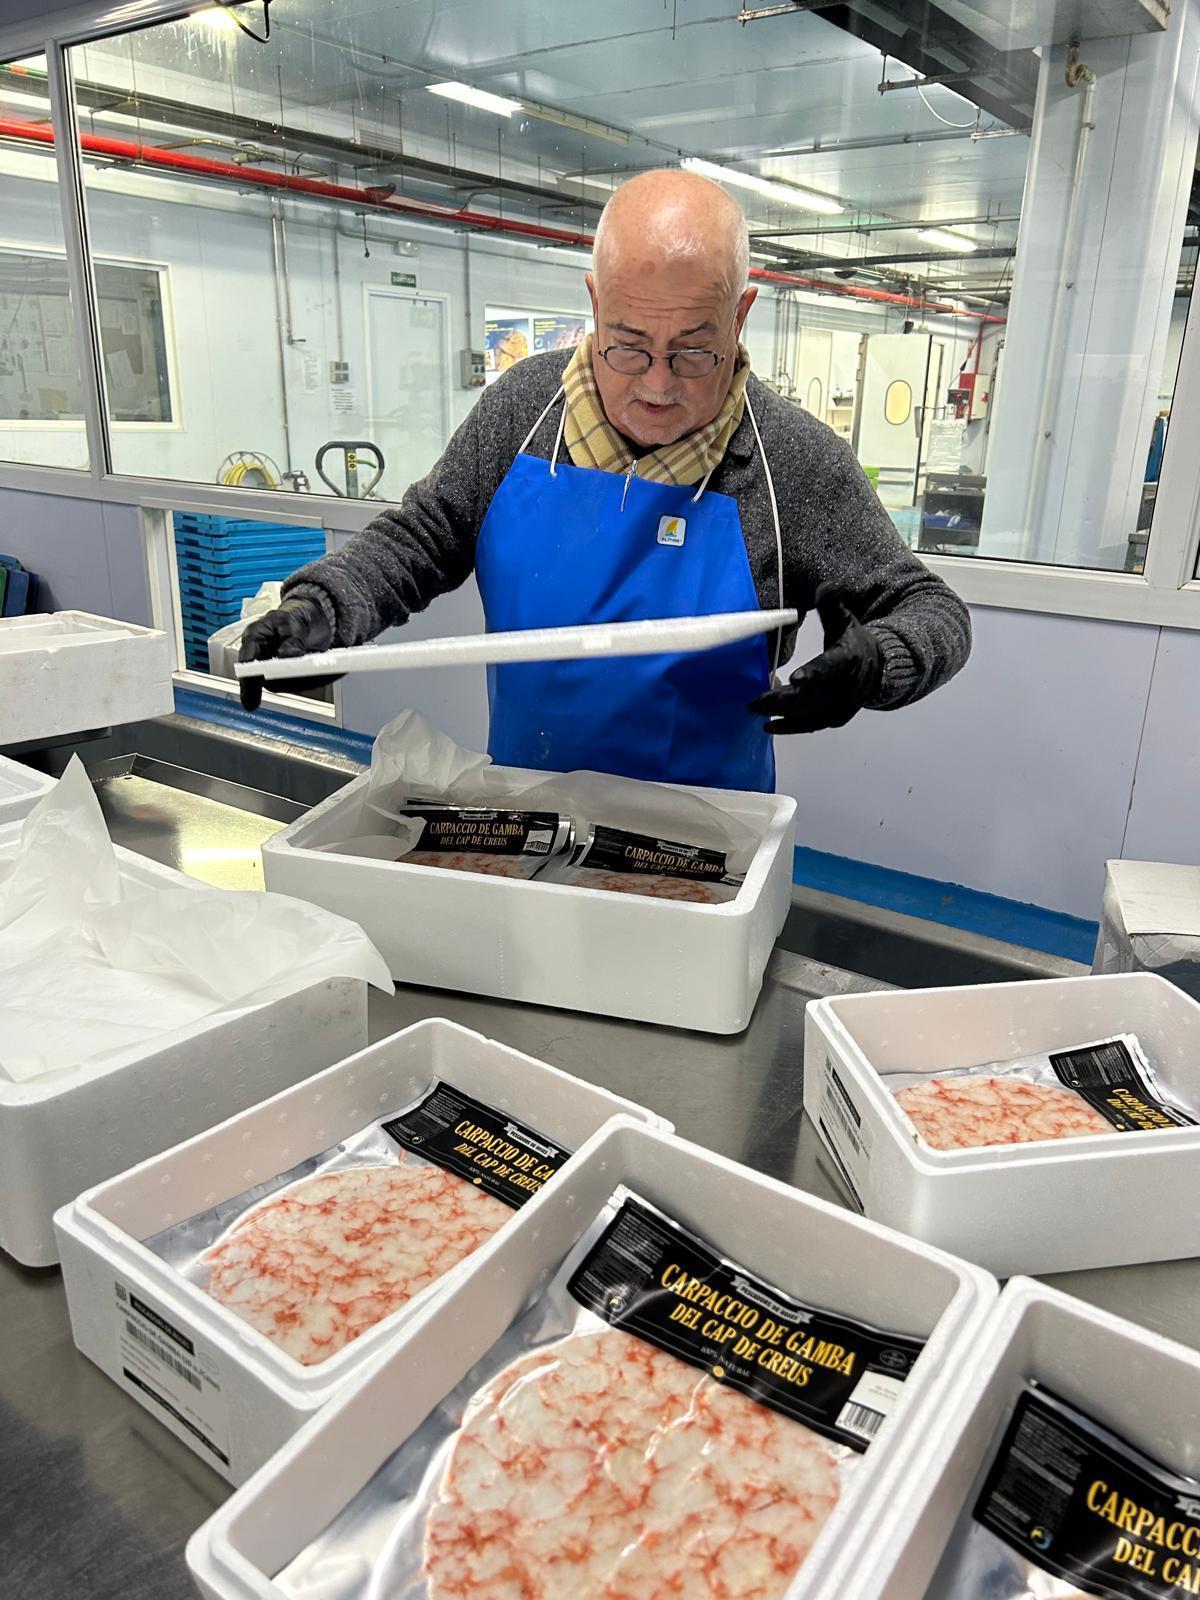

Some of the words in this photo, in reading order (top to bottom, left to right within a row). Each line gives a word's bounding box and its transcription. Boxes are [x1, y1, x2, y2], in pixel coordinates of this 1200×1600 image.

[429, 822, 476, 834] CARPACCIO
[478, 823, 491, 835] DE
[492, 823, 524, 836] GAMBA
[440, 836, 454, 845] DEL
[456, 836, 470, 845] CAP
[471, 836, 482, 845] DE
[483, 837, 508, 846] CREUS
[624, 845, 674, 865] CARPACCIO
[676, 856, 691, 868] DE
[453, 1143, 478, 1158] DEL
[473, 1153, 499, 1169] CAP
[493, 1163, 514, 1178] DE
[508, 1172, 544, 1194] CREUS
[454, 1120, 520, 1161] CARPACCIO
[513, 1153, 539, 1172] DE
[532, 1164, 555, 1181] GA
[661, 1263, 760, 1329] CARPACCIO
[755, 1318, 788, 1346] DE
[785, 1330, 856, 1377] GAMBA
[669, 1302, 703, 1331] DEL
[701, 1318, 737, 1345] CAP
[732, 1335, 761, 1361] DE
[757, 1348, 814, 1388] CREUS
[1087, 1480, 1200, 1557] CARPACC
[1112, 1537, 1157, 1576] DEL
